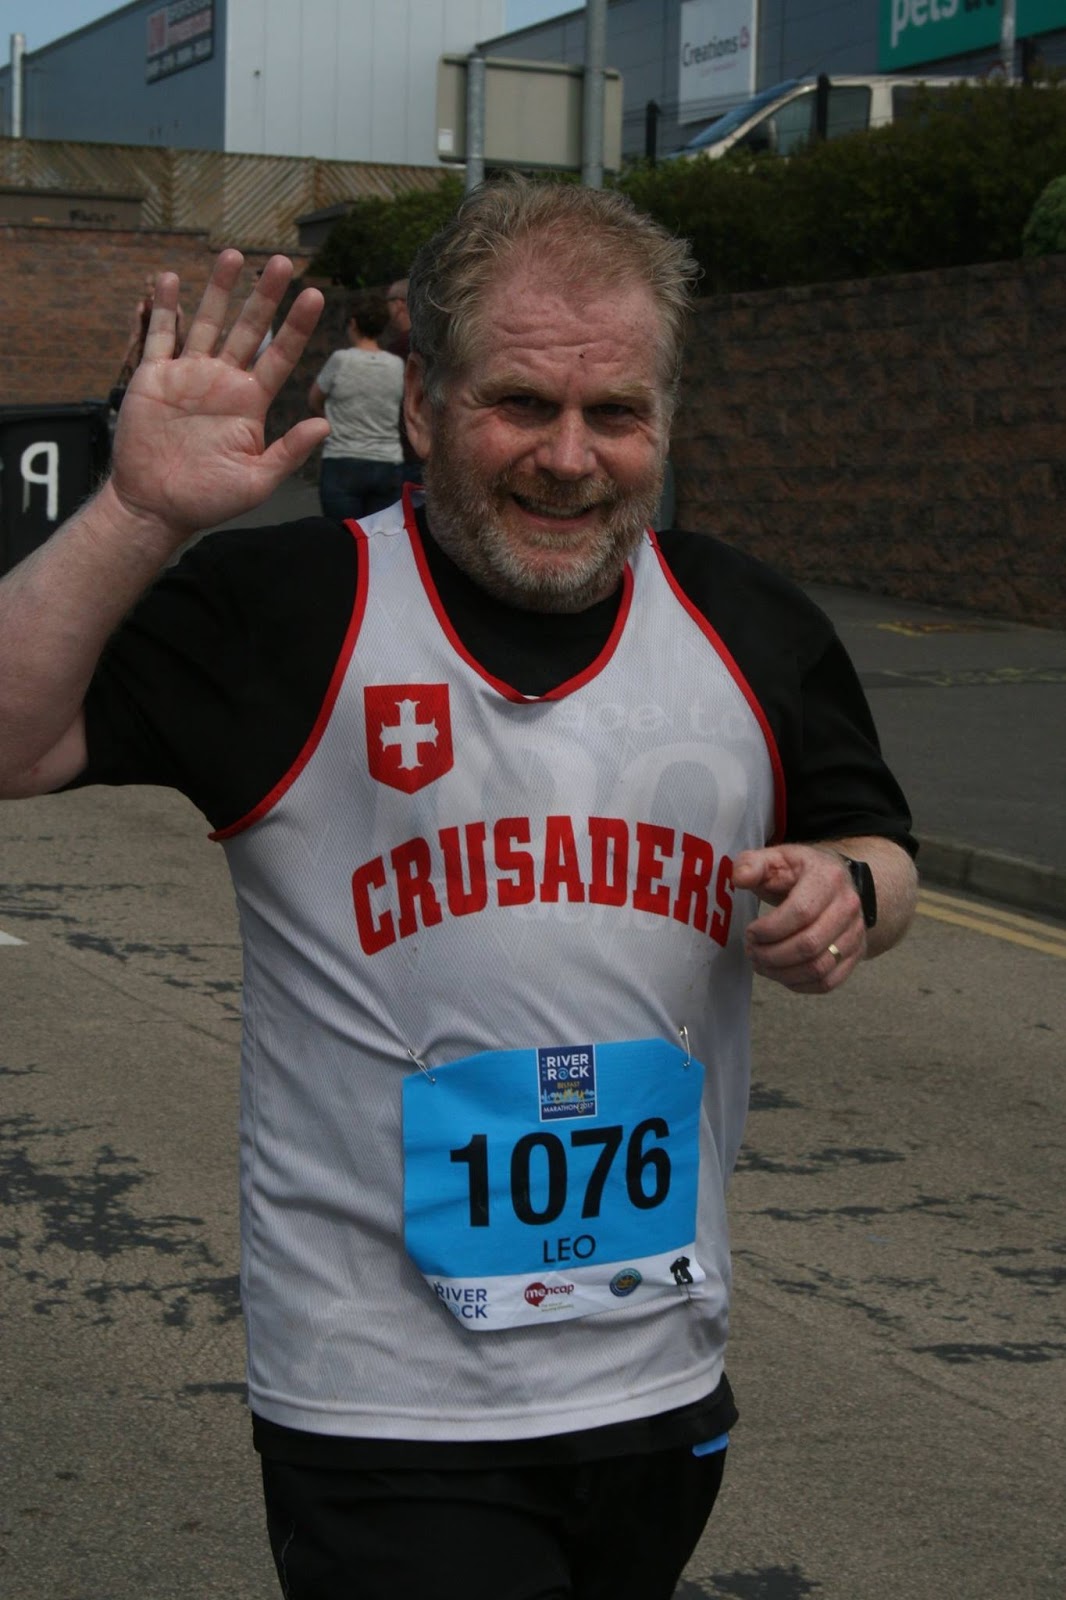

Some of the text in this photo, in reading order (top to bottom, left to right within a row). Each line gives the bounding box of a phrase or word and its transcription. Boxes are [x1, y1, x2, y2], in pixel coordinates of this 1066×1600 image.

[682, 35, 738, 67] Creations
[20, 441, 59, 521] 9
[352, 815, 736, 955] CRUSADERS
[546, 1053, 589, 1067] RIVER
[547, 1066, 589, 1080] ROCK
[543, 1104, 578, 1112] MARATHON
[450, 1117, 671, 1228] 1076
[543, 1234, 596, 1264] LEO
[434, 1283, 488, 1303] RIVER
[525, 1283, 575, 1299] mencap
[449, 1302, 488, 1319] OCK
